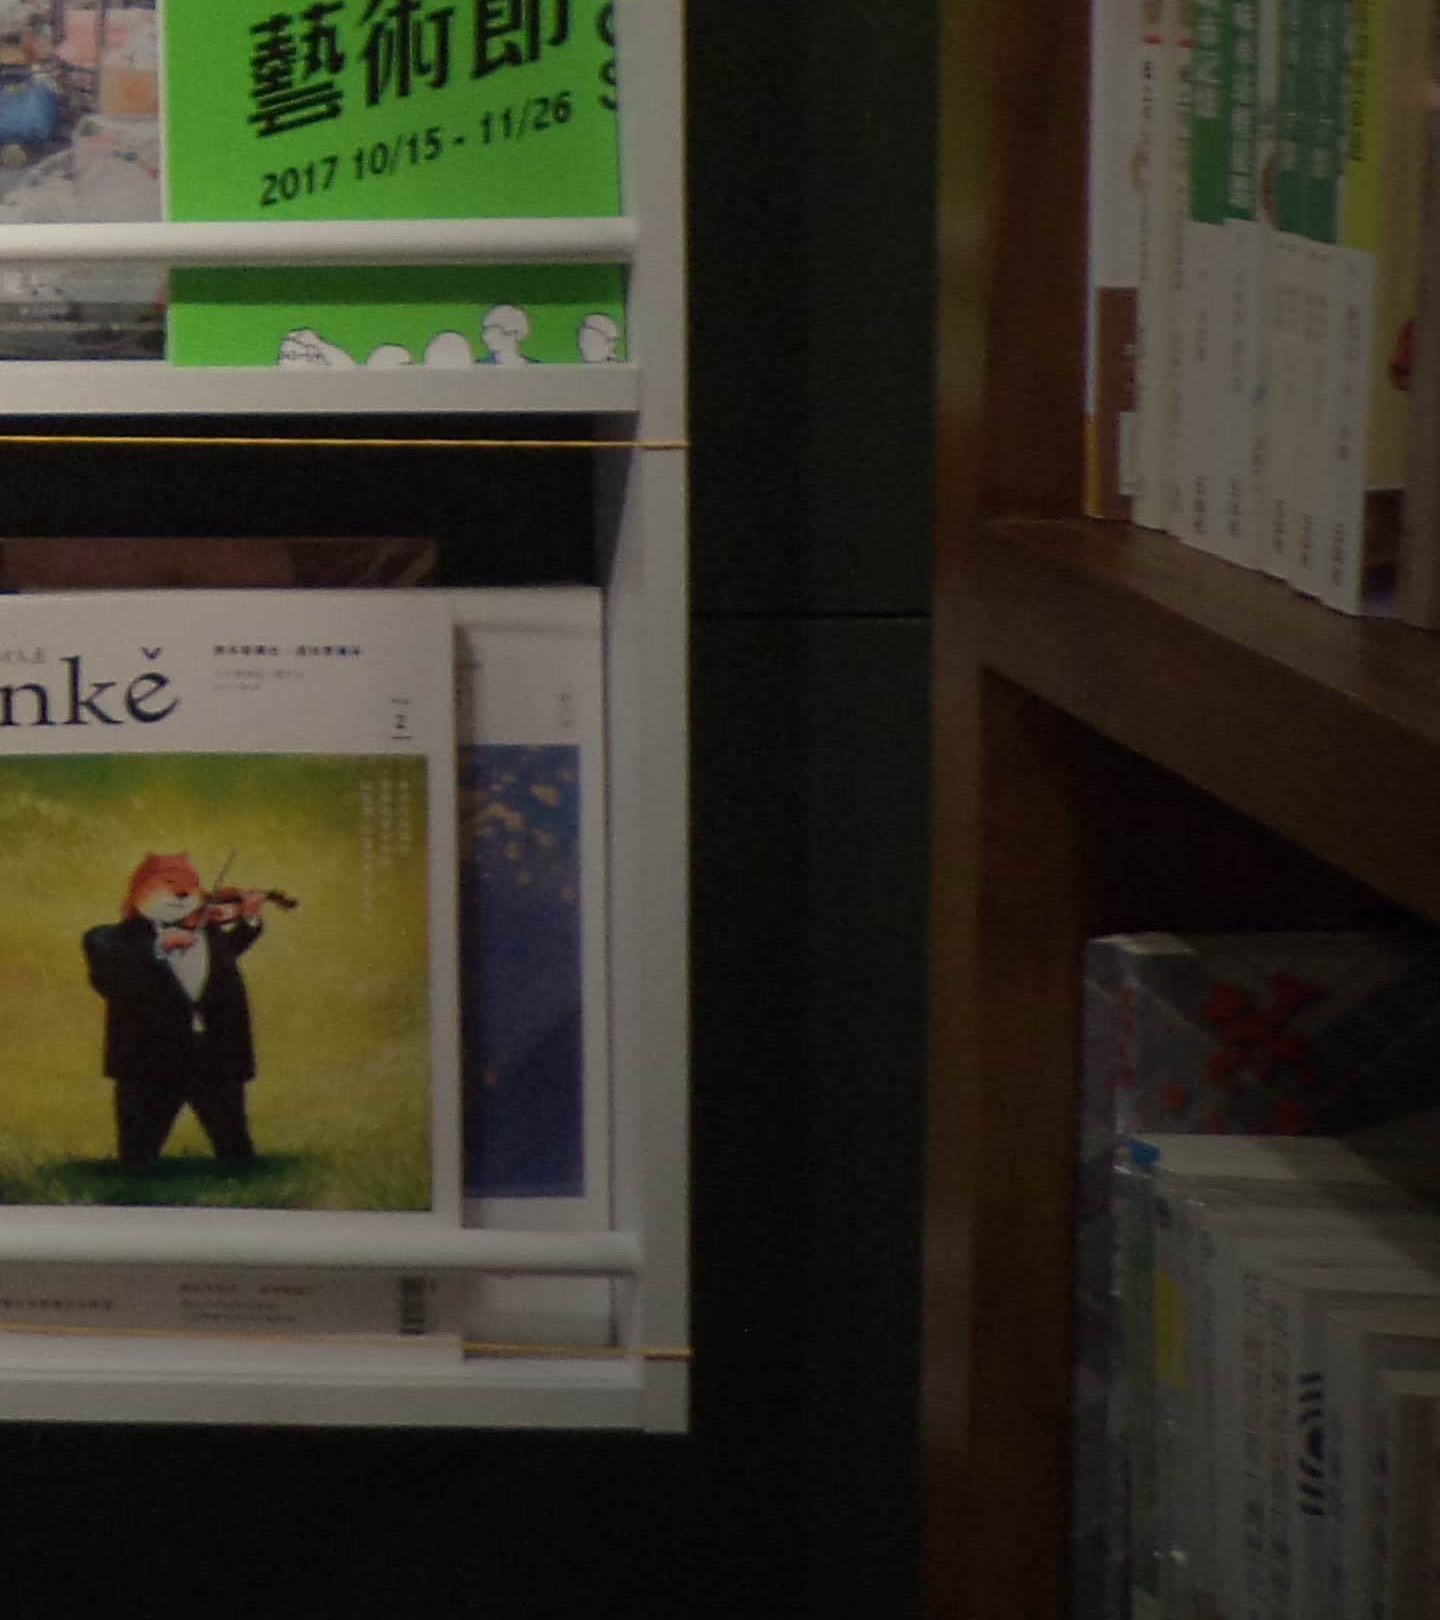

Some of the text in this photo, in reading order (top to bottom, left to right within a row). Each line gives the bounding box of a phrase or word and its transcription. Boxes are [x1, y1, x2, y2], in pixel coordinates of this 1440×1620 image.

[257, 155, 340, 209] 2017
[349, 122, 444, 180] 10/15
[480, 89, 574, 148] 11/26
